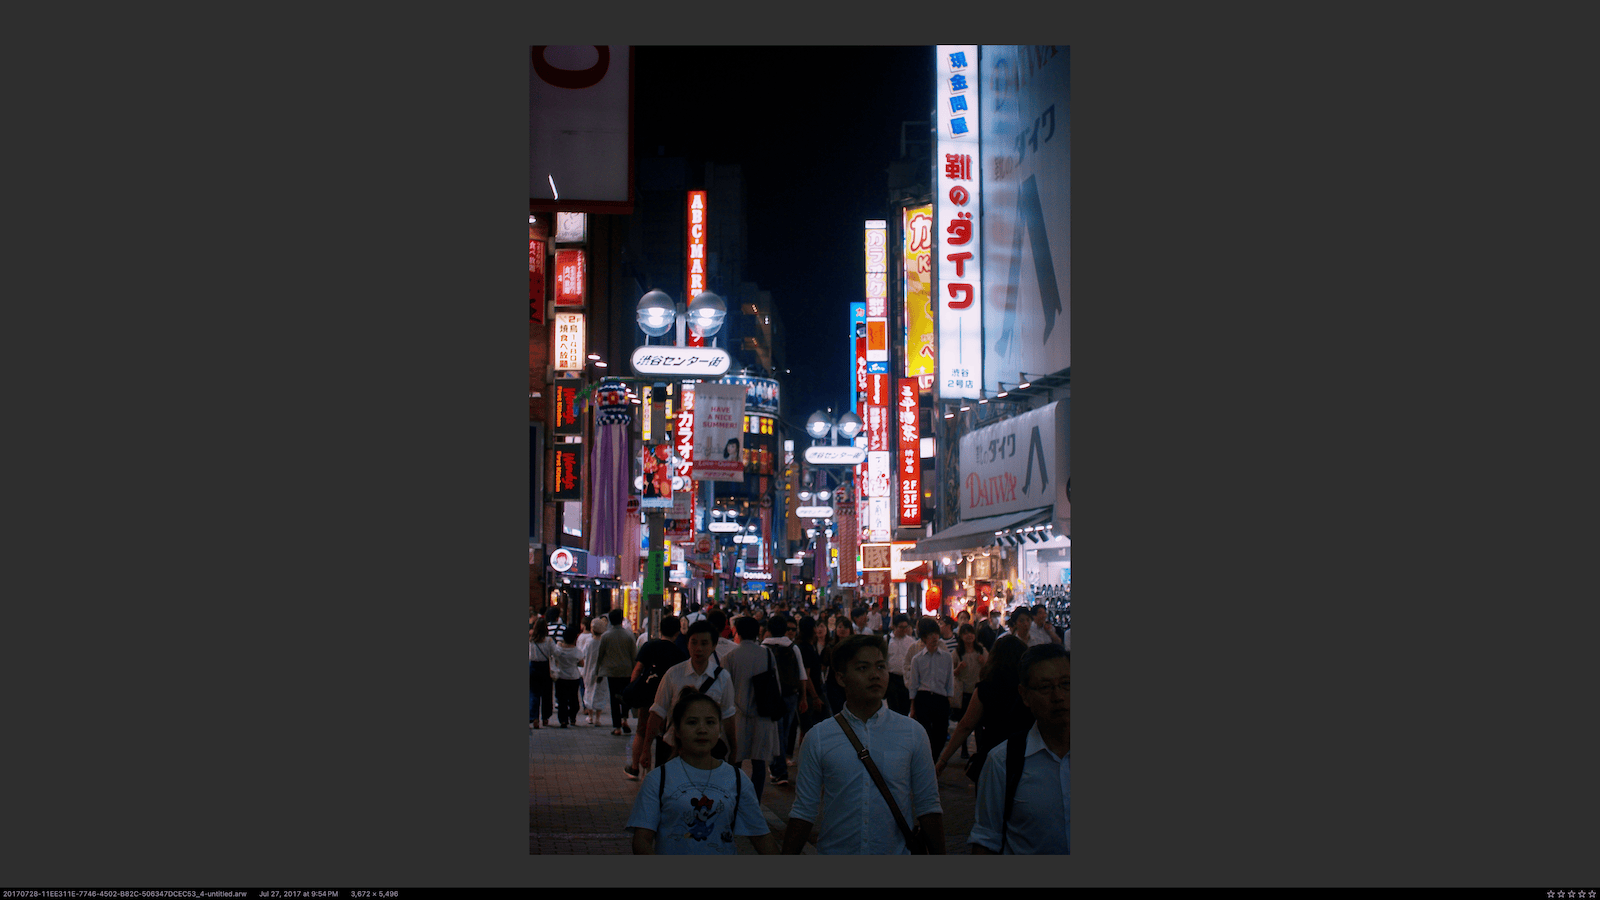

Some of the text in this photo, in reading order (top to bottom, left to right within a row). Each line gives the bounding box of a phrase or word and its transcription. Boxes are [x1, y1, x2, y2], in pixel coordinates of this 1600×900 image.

[945, 153, 973, 310] 靴のダイワ
[868, 231, 886, 296] カラオケ
[637, 355, 724, 367] 渋谷センター街
[703, 421, 738, 429] SUMMER!
[678, 411, 694, 475] カラオケ
[562, 453, 577, 490] Wendy's
[903, 480, 917, 490] 2F
[966, 472, 1017, 508] DAIWA
[903, 494, 917, 504] 3F
[903, 508, 917, 518] 4F
